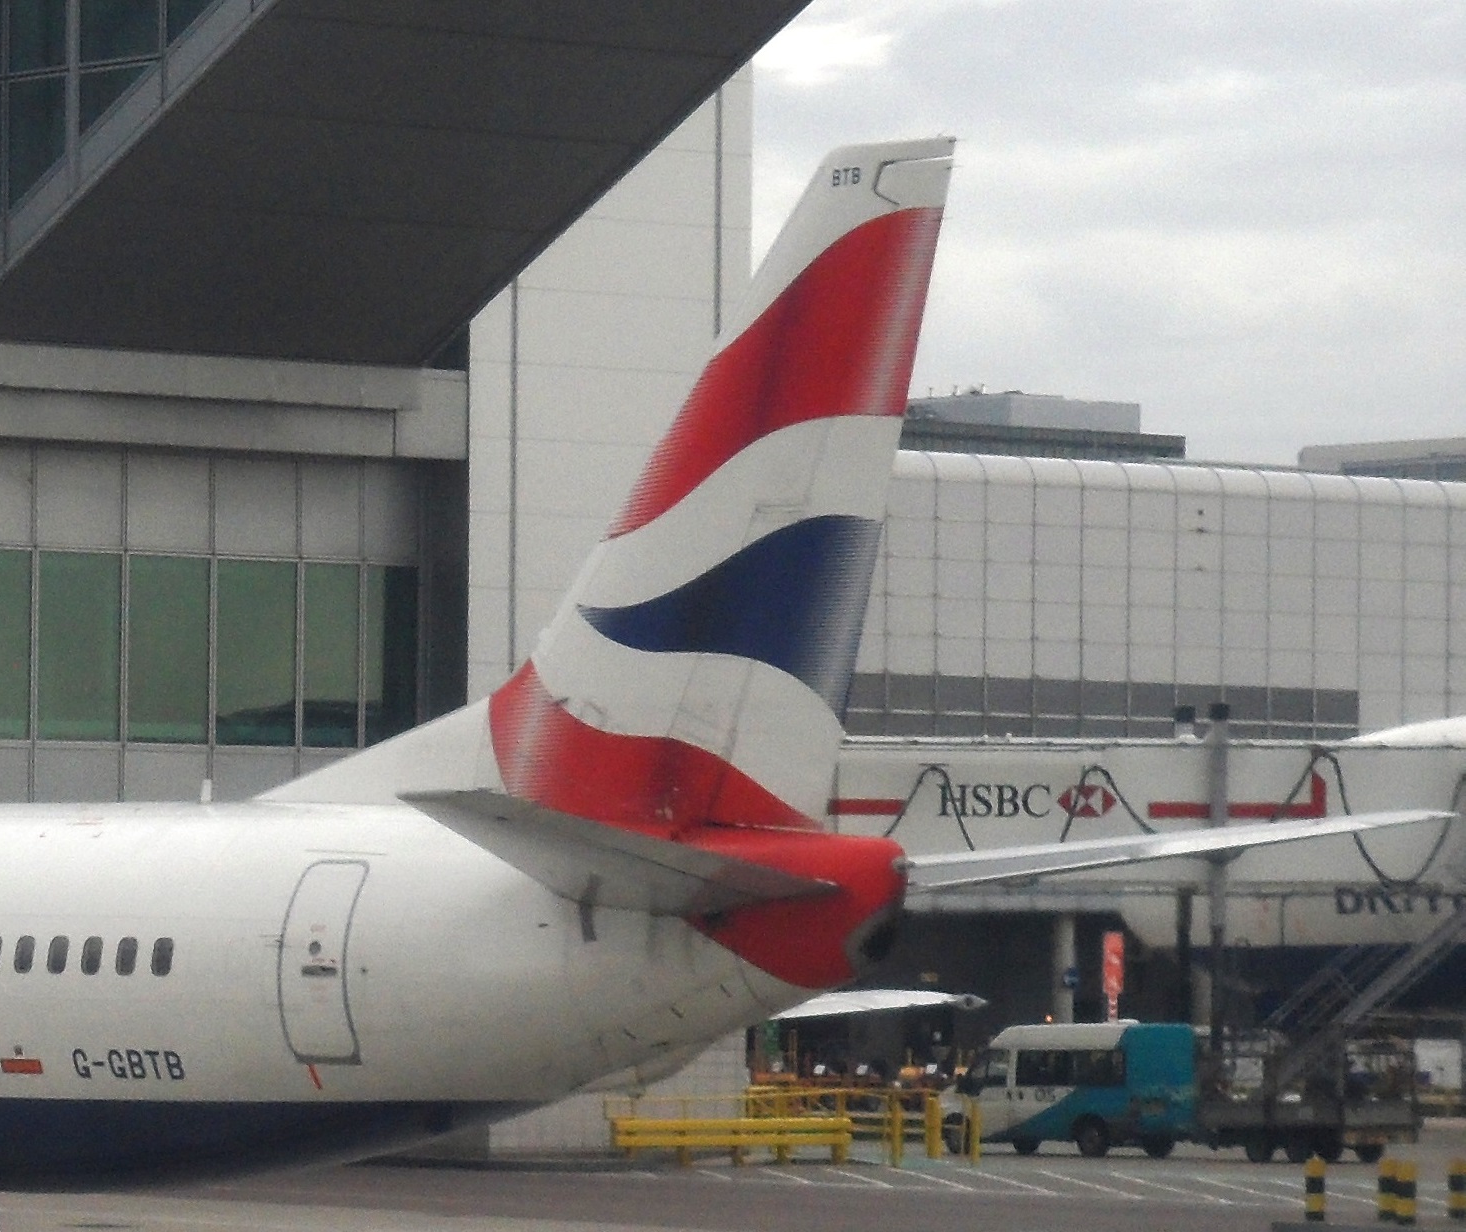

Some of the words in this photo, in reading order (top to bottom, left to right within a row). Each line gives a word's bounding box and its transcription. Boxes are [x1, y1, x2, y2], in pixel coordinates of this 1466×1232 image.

[832, 167, 860, 186] BTB
[937, 783, 1051, 817] HSBC
[72, 1048, 185, 1080] G-GBTB
